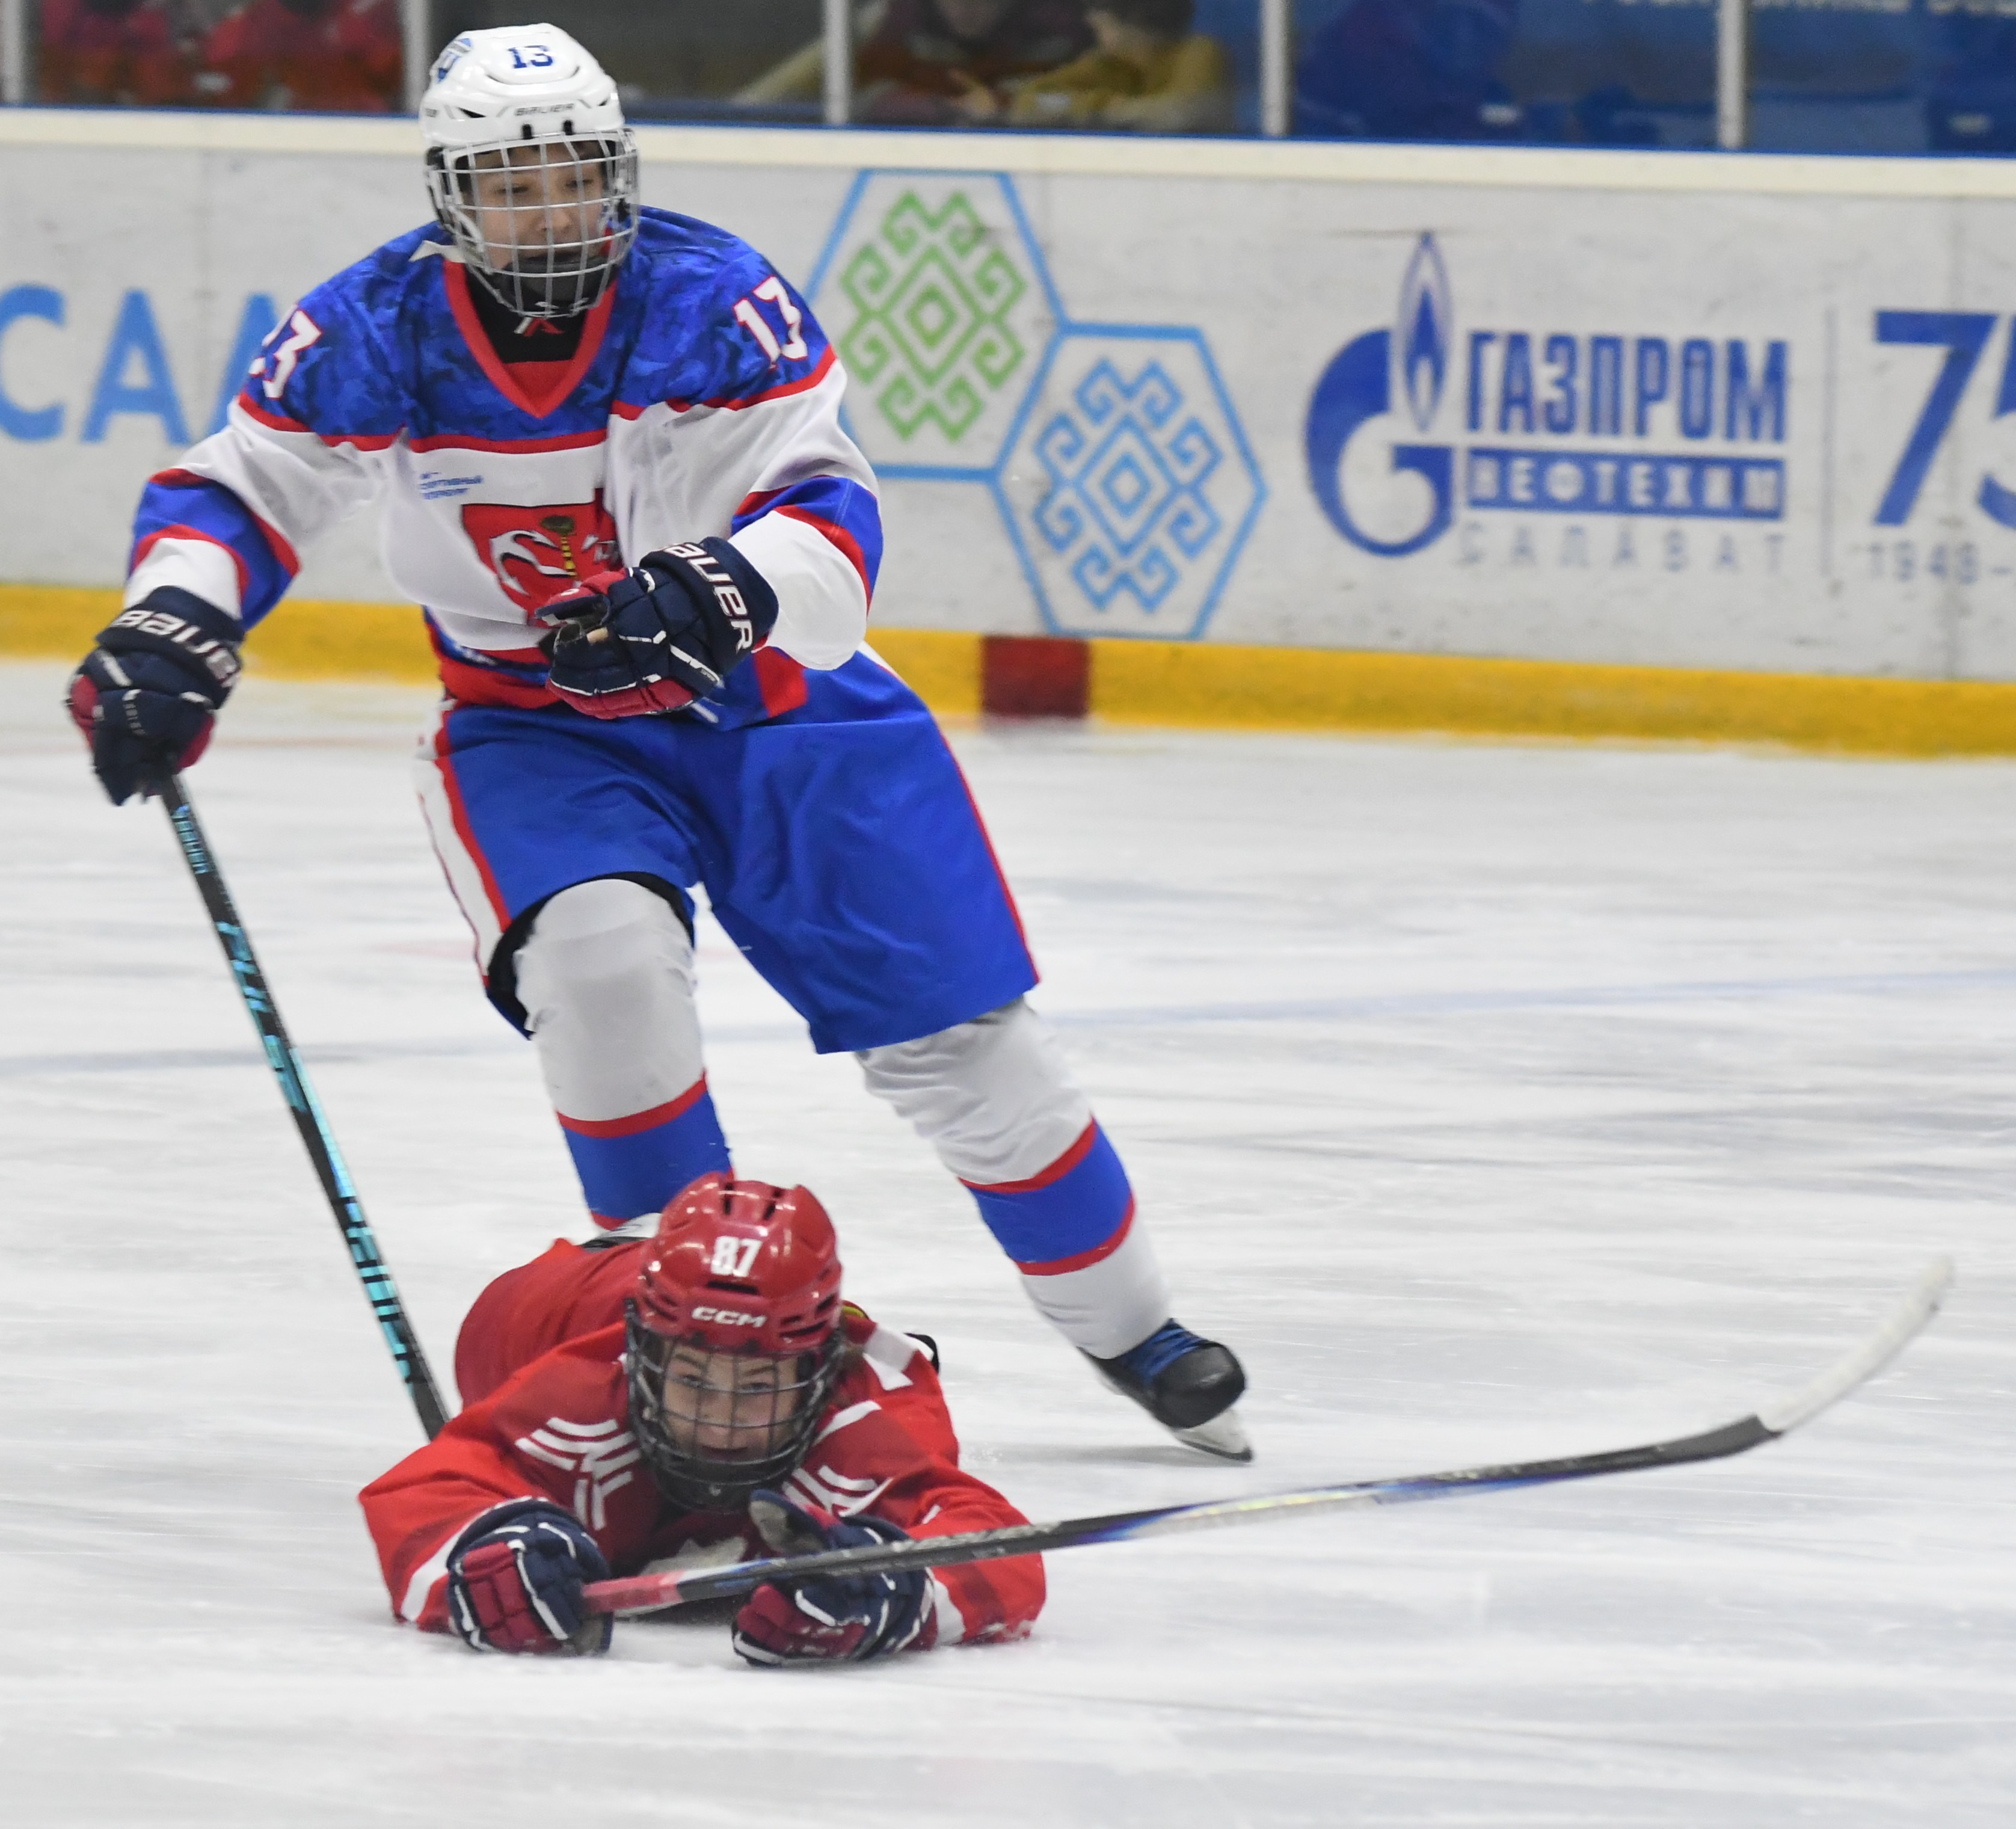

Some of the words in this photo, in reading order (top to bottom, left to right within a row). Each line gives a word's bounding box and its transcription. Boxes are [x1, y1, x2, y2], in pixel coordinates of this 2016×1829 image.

[507, 45, 555, 69] 13
[732, 274, 808, 372] 13
[1466, 330, 1789, 443] ГАЗПРОМ
[1471, 455, 1779, 511] НЕФТЕХИМ
[656, 541, 753, 654] AUER
[710, 1235, 762, 1277] 87
[691, 1306, 767, 1328] CCM
